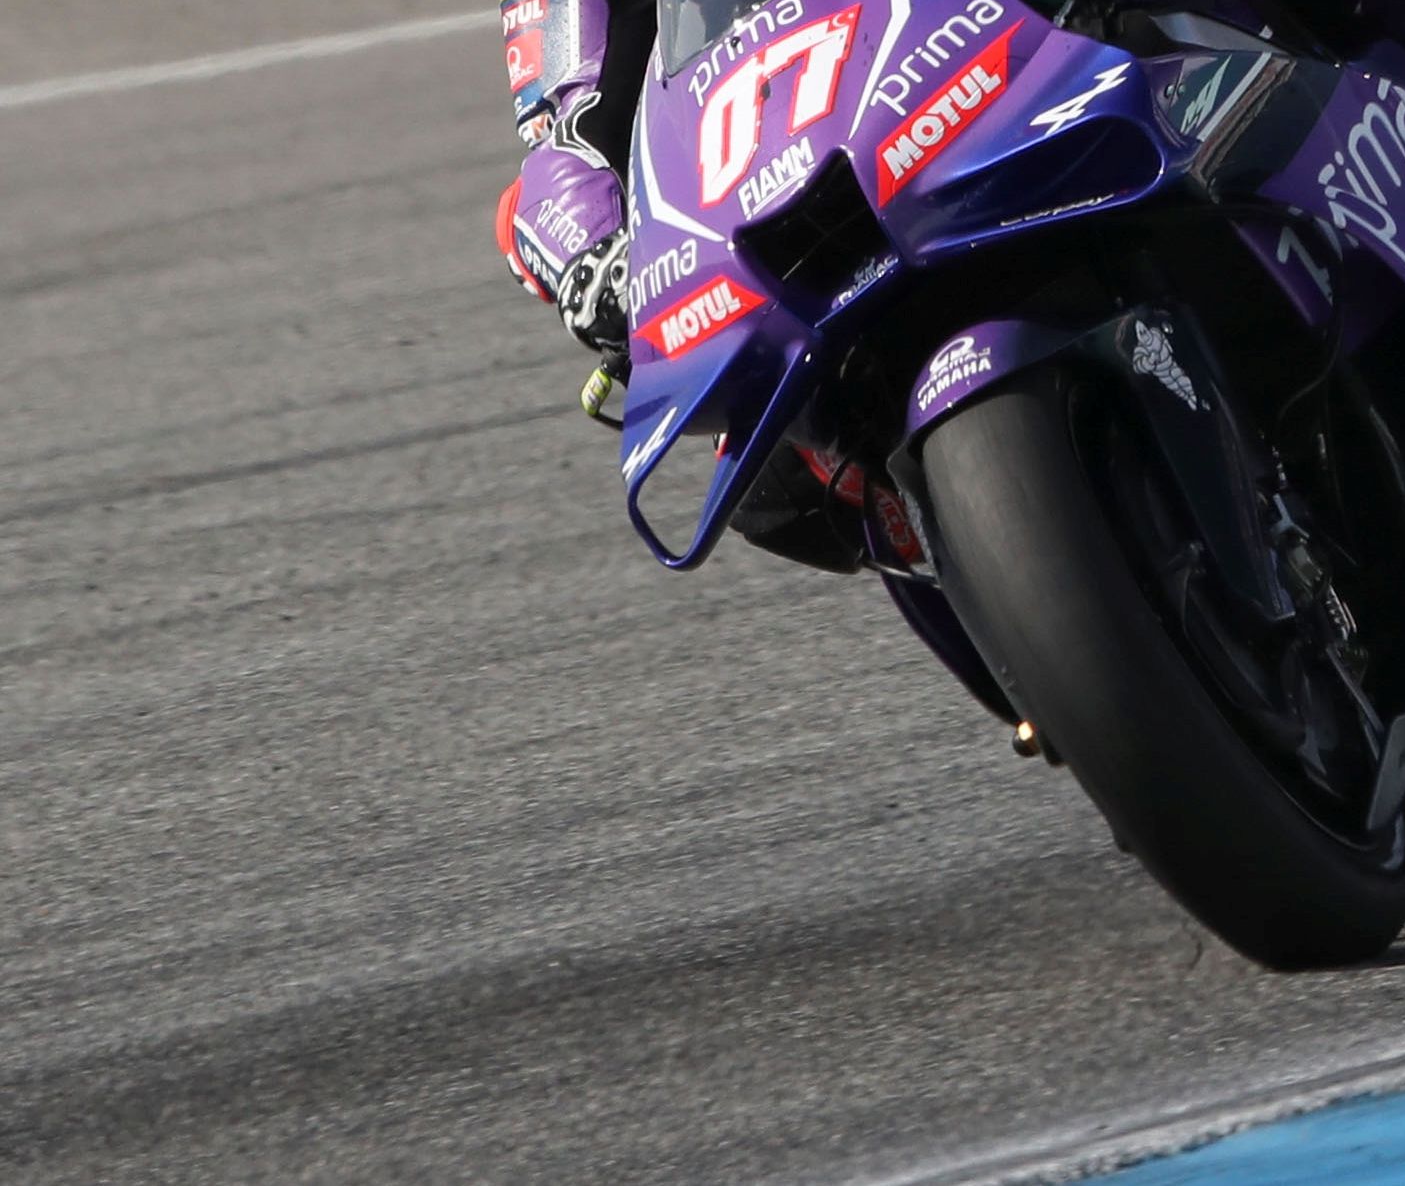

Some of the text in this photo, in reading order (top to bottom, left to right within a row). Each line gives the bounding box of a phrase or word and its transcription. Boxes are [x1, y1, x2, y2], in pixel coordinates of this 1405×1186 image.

[699, 14, 852, 208] 07
[881, 63, 1003, 181] MOTUL
[736, 136, 817, 220] FIAMM
[536, 197, 589, 255] prima
[628, 238, 698, 330] prima
[659, 282, 744, 354] MOTUL
[918, 355, 993, 412] YAMAHA
